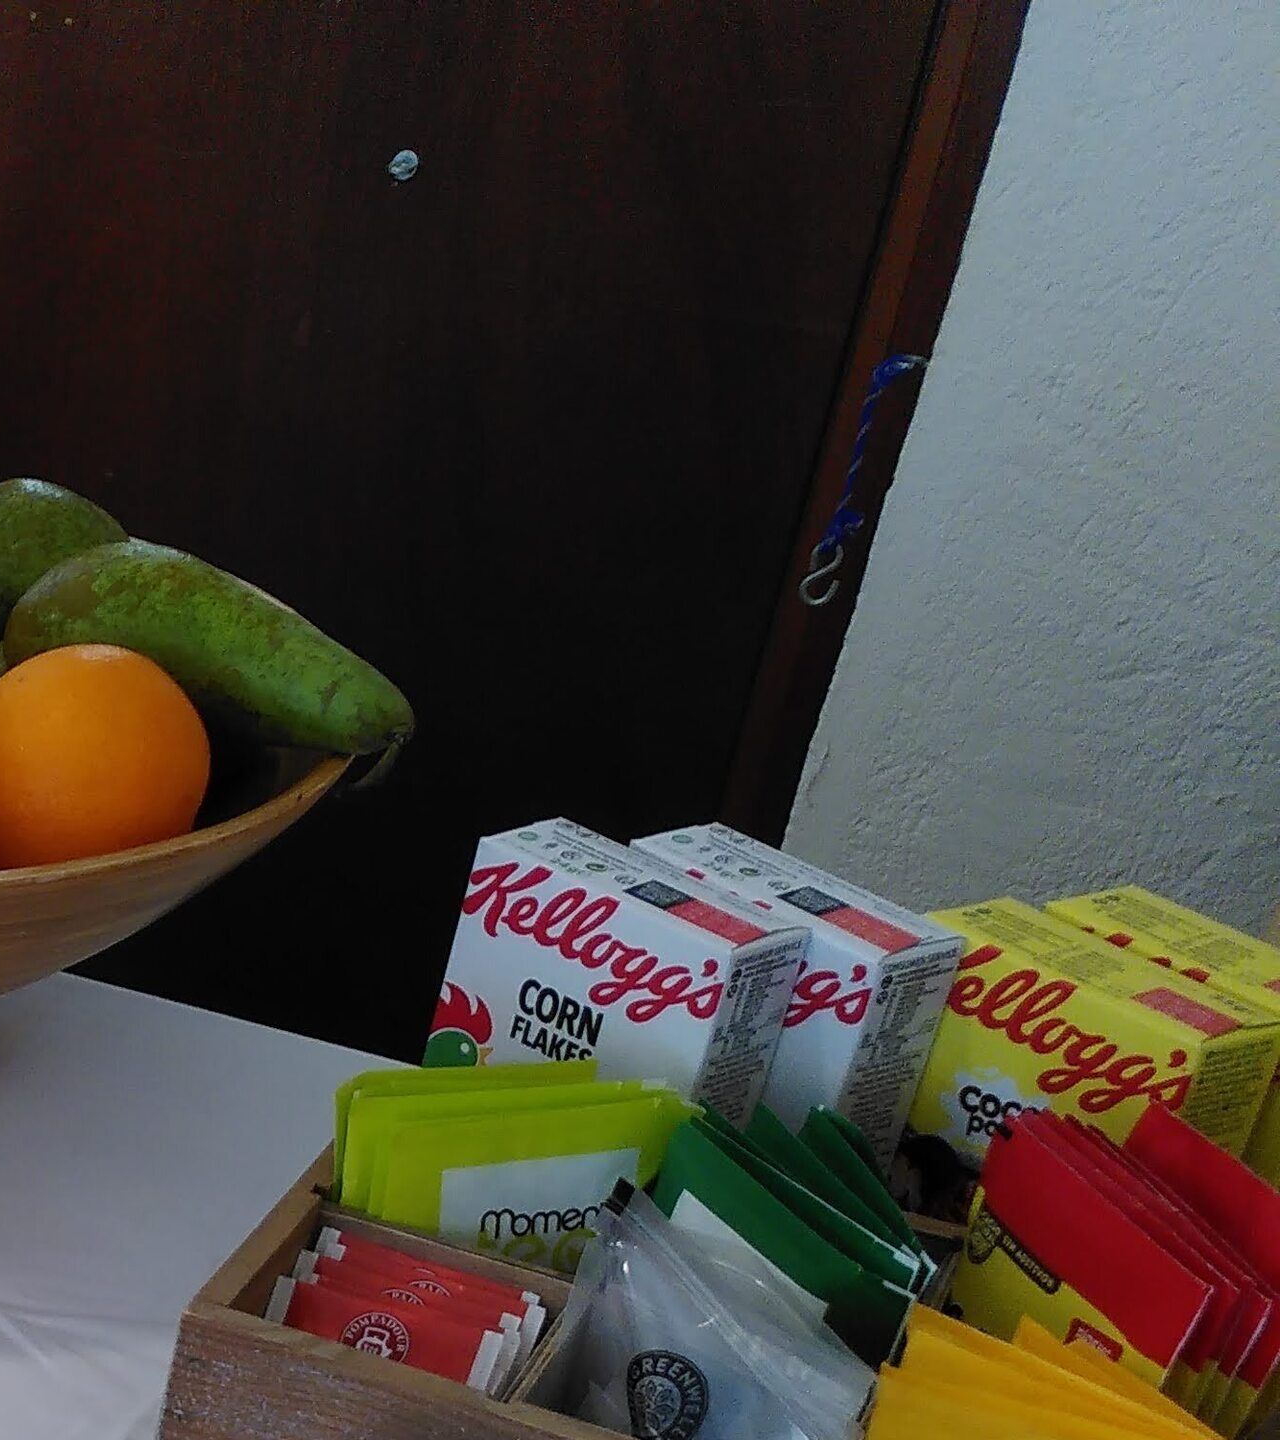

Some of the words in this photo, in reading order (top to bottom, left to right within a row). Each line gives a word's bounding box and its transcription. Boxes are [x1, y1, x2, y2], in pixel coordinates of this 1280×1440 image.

[461, 861, 725, 1024] Kellogg's
[519, 978, 604, 1047] CORN
[945, 944, 1193, 1115] ellogg's
[345, 1313, 406, 1352] POMPADOUR
